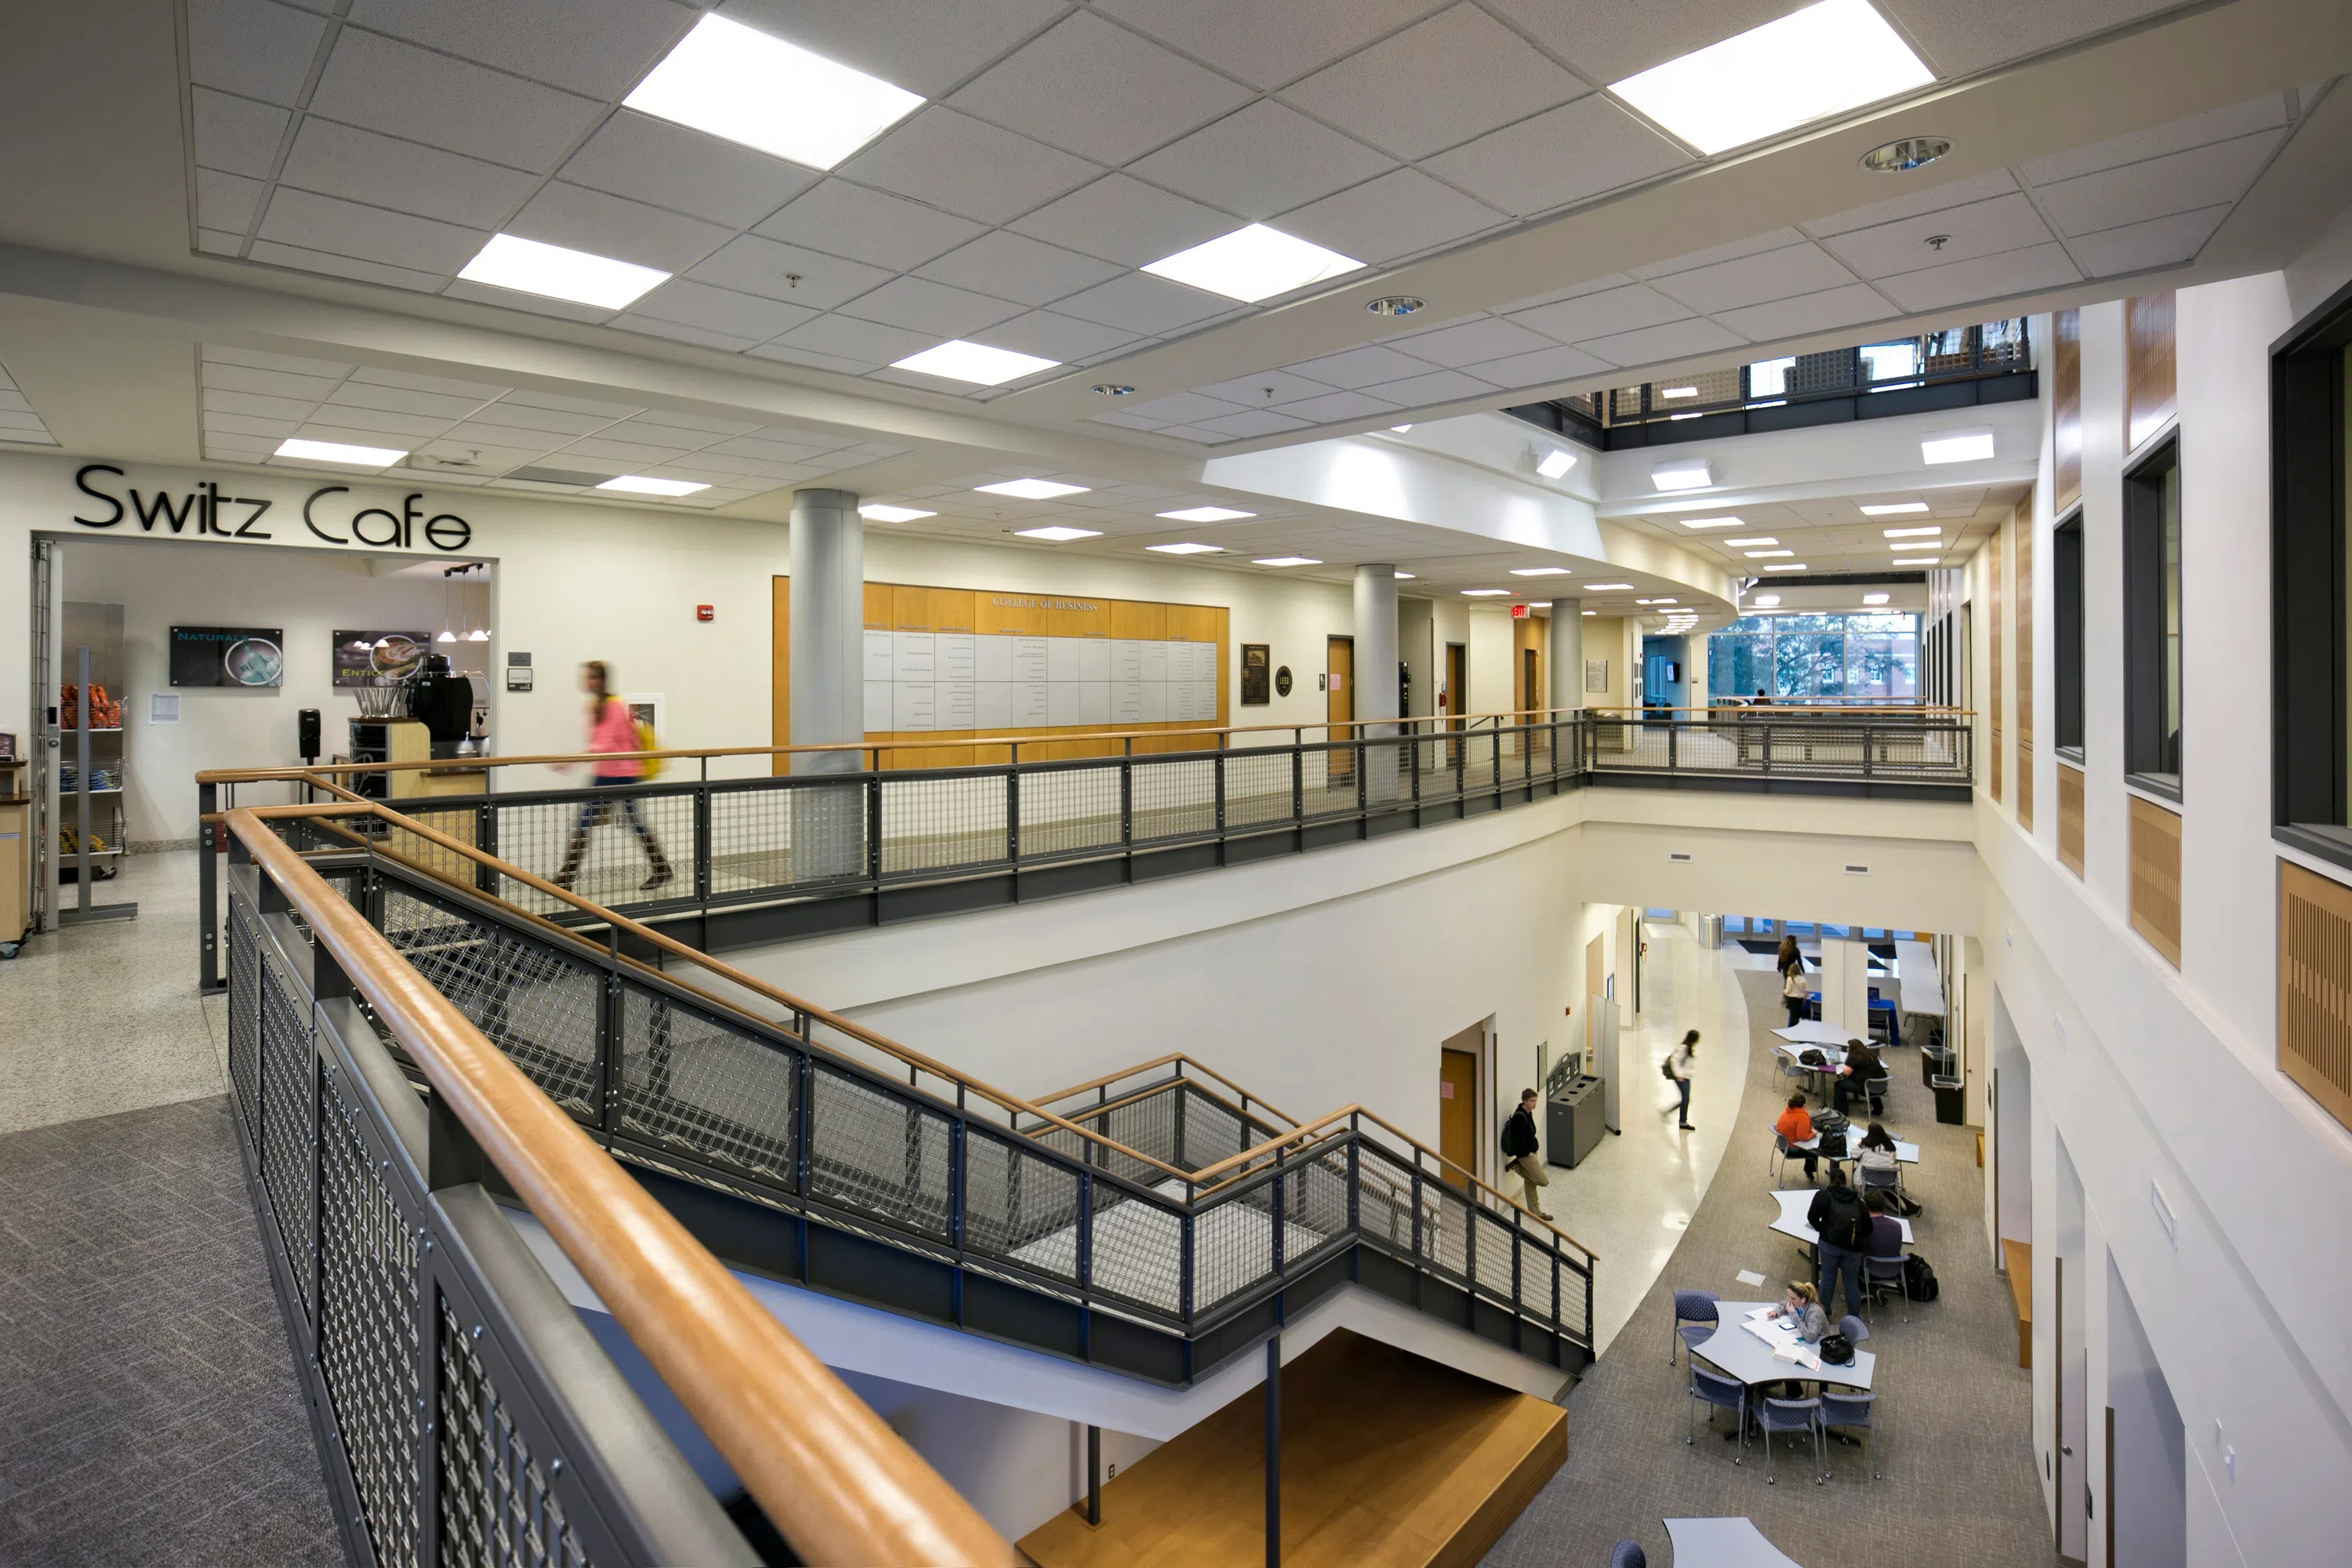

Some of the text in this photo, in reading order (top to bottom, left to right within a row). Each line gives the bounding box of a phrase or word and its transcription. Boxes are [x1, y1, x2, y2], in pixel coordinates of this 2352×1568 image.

[74, 464, 471, 551] Switz Cafe
[992, 597, 1098, 612] COLLEGE OF BUSINESS
[1514, 608, 1526, 618] EXIT
